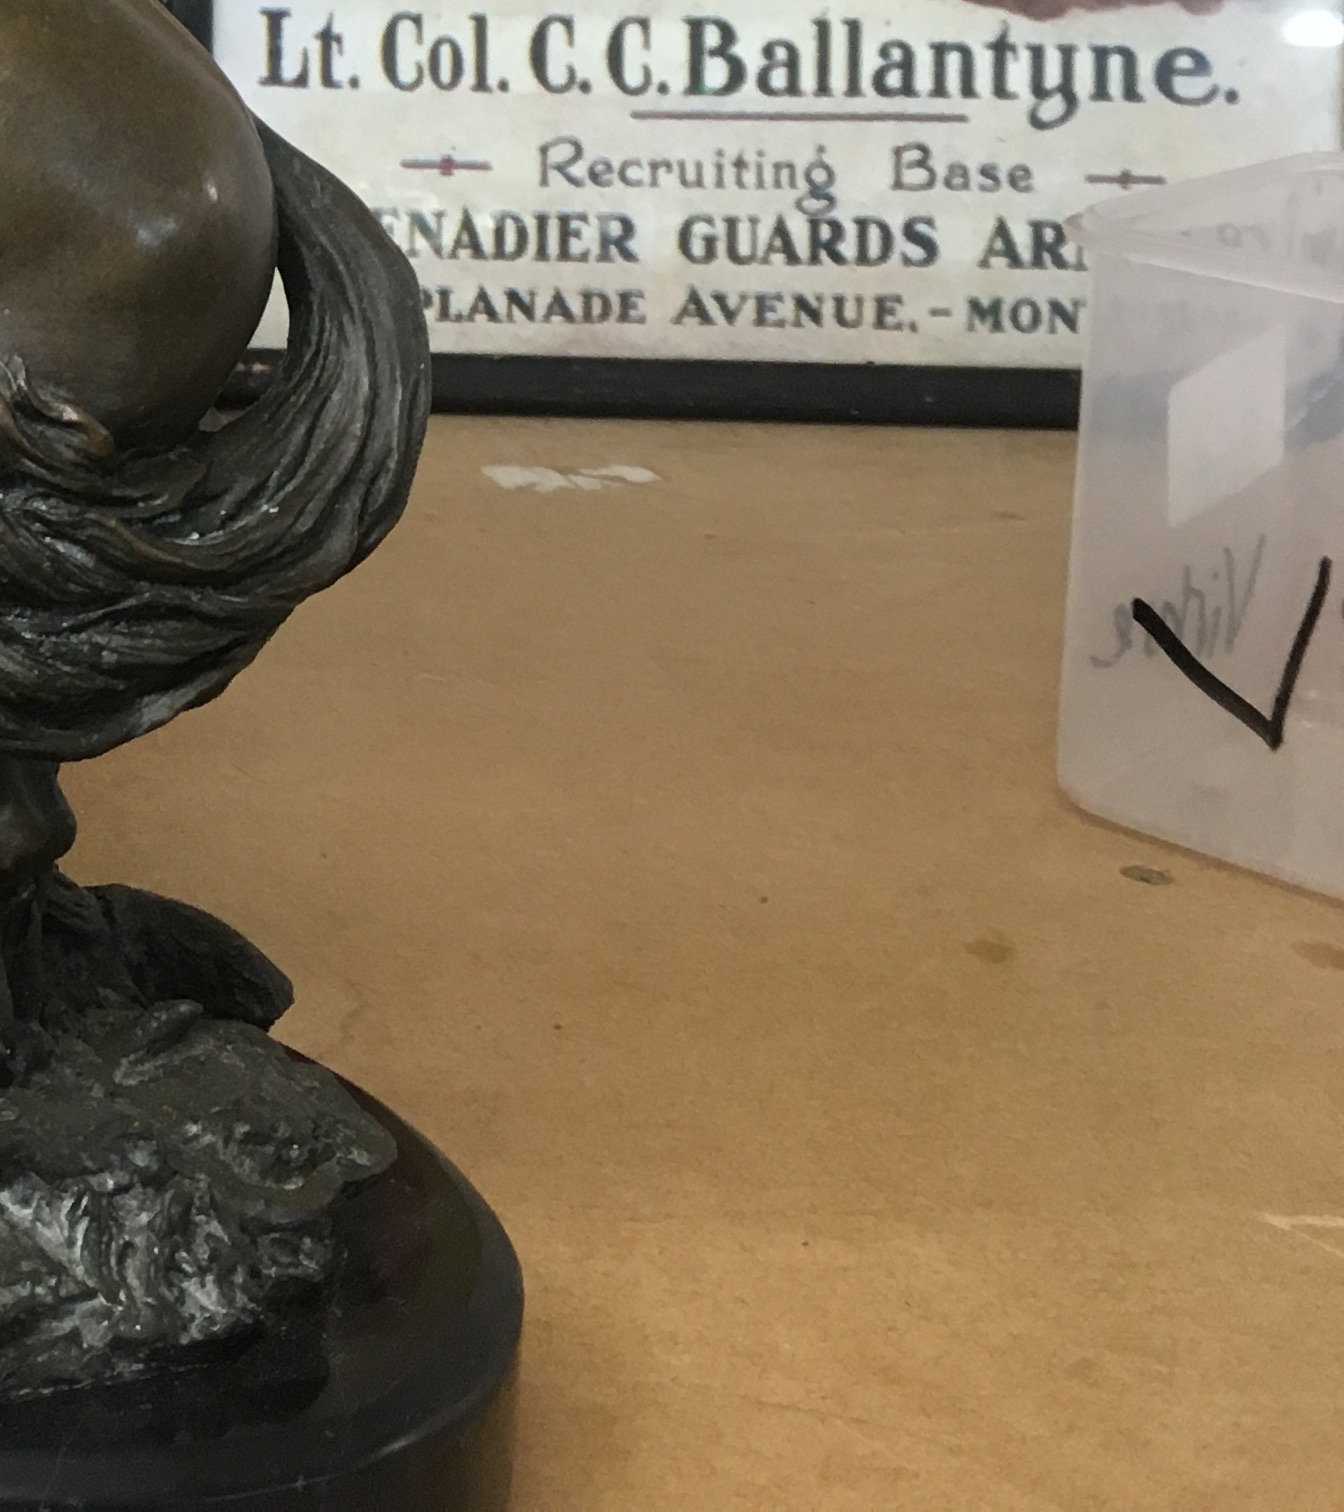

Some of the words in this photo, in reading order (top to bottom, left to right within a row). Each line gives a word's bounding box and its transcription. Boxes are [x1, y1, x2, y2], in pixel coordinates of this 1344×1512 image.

[257, 6, 360, 90] Lt.
[379, 10, 511, 93] Col.
[538, 136, 836, 216] Recruiting
[890, 141, 1034, 193] Base
[677, 212, 941, 269] GUARDS
